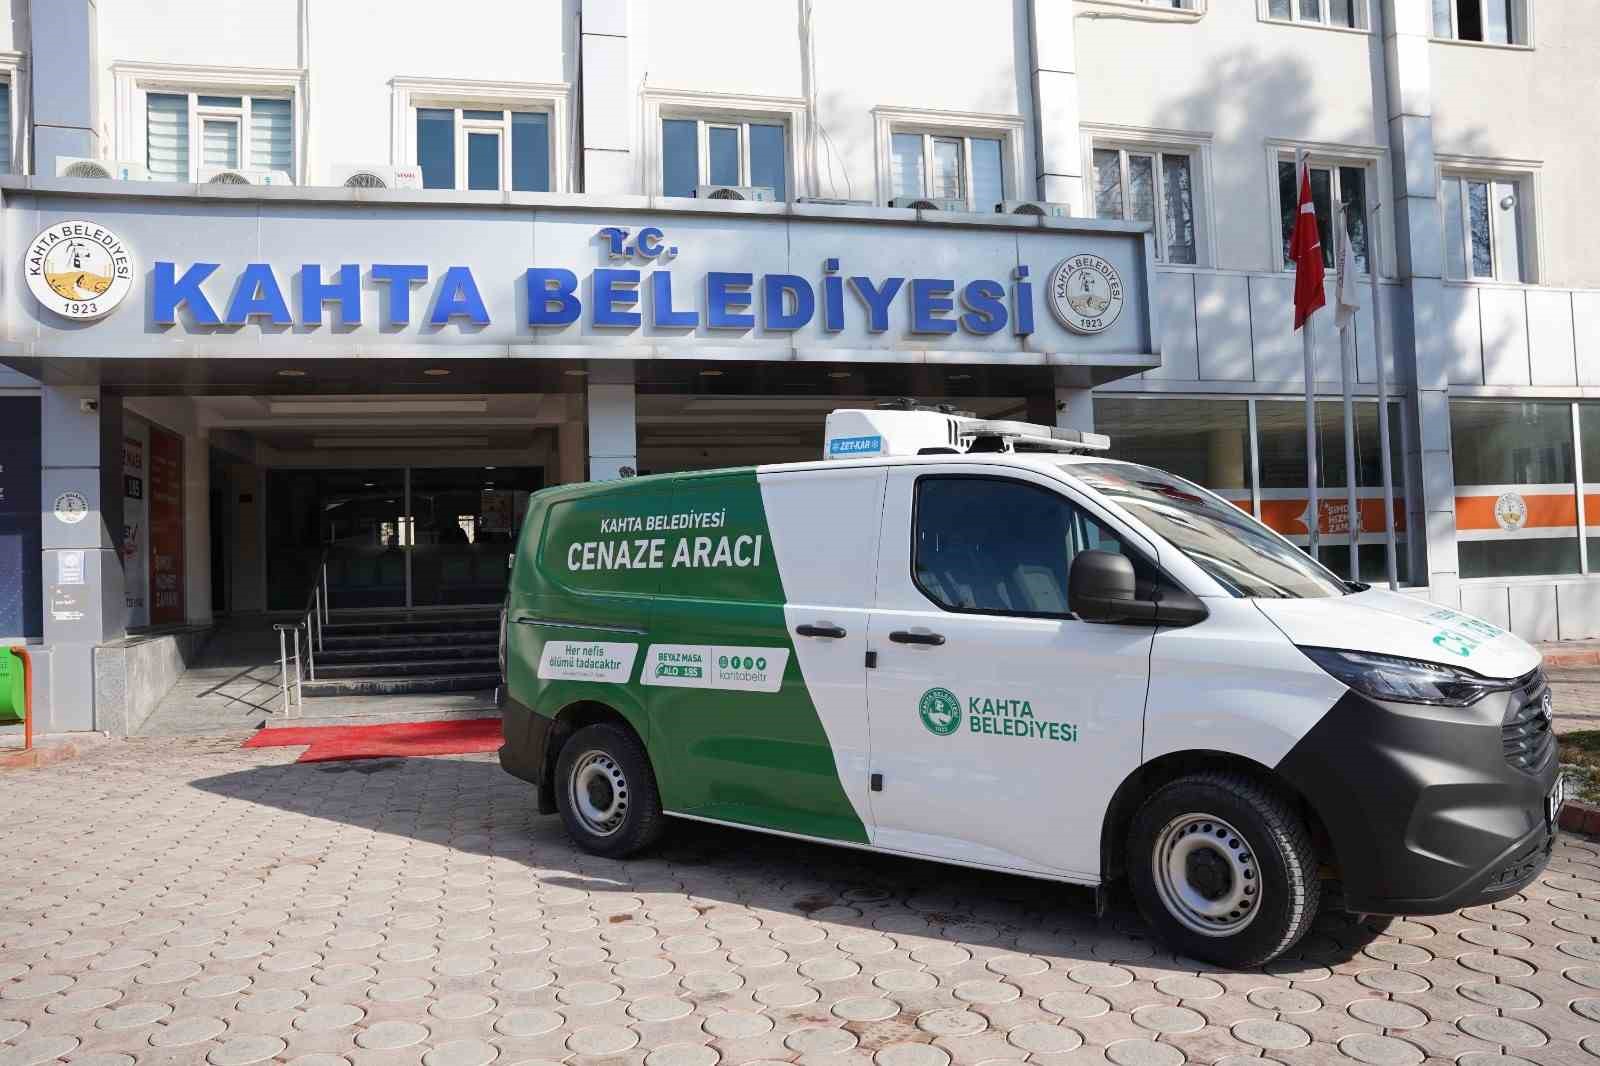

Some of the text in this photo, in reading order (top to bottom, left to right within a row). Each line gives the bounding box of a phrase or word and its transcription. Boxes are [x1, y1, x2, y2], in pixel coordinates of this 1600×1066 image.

[30, 225, 131, 279] KAHTA BELEDİYESİ
[599, 227, 679, 256] T.C.
[64, 303, 98, 314] 1923
[153, 258, 1035, 336] KAHTA BELEDİYESİ
[600, 507, 727, 534] KAHTA BELEDİYESİ
[567, 534, 763, 571] CENAZE ARACI
[565, 644, 605, 657] Her nefis
[657, 652, 703, 663] BEYAZ MASA
[968, 696, 1034, 719] KAHTA
[969, 715, 1079, 743] BELEDİYESİ
